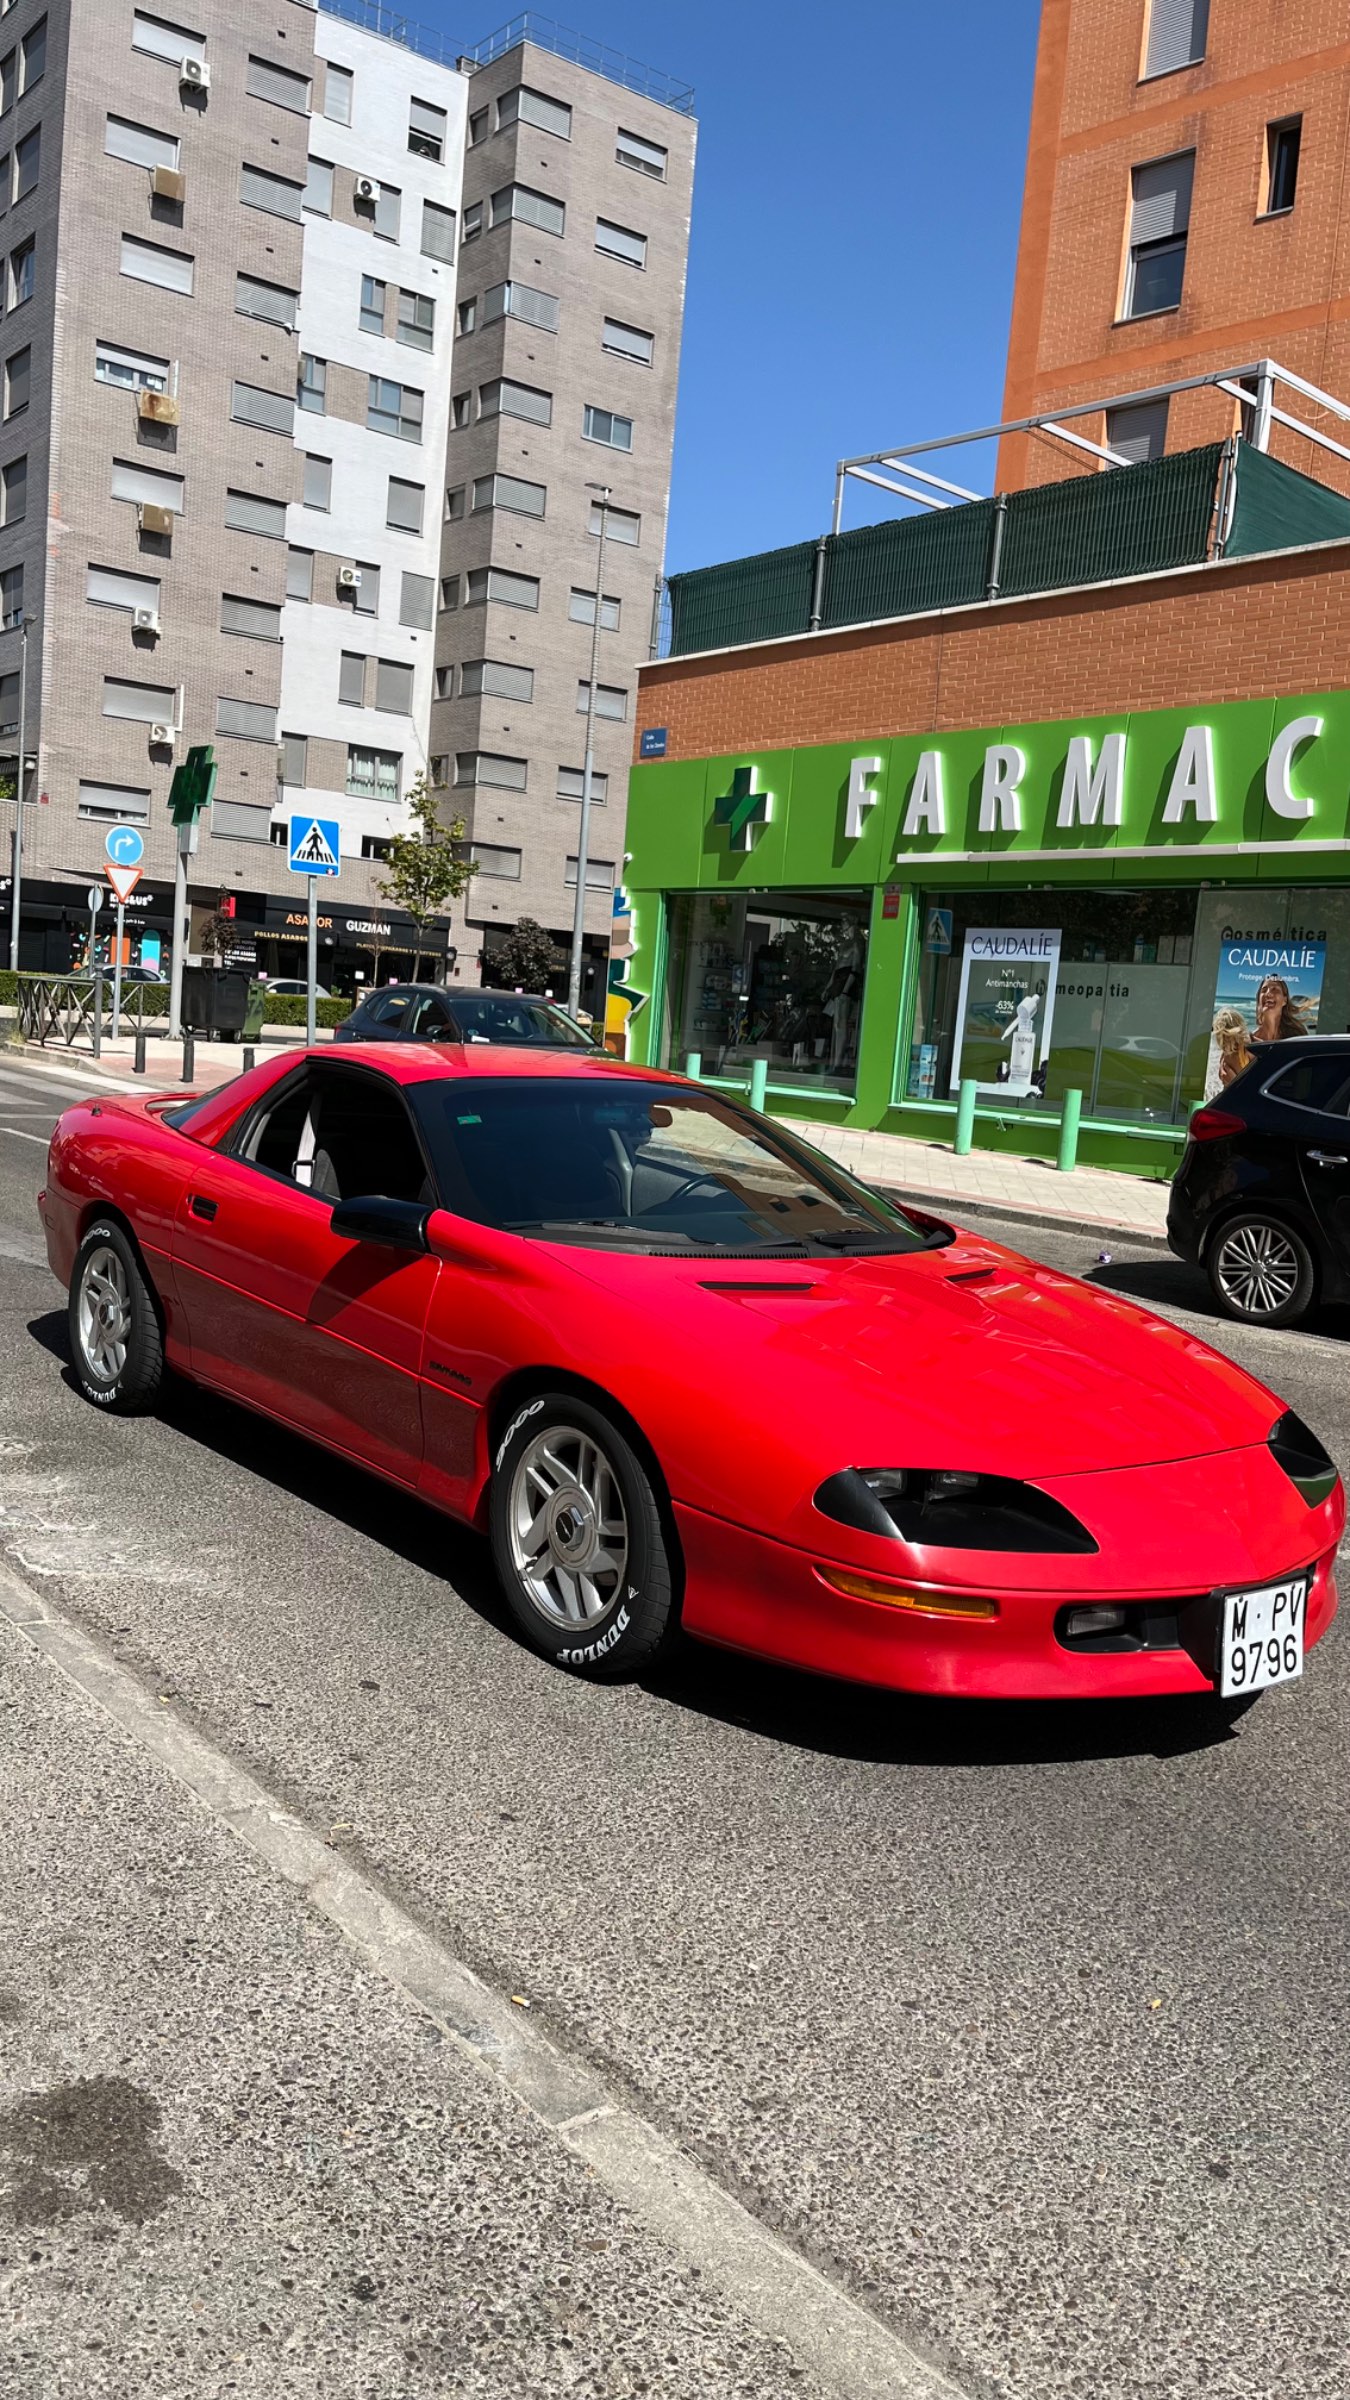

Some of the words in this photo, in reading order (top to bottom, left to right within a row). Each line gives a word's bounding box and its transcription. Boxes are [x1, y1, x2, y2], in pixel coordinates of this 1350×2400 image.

[844, 715, 1324, 838] FARMAC
[254, 930, 280, 939] POLLOS
[281, 933, 309, 942] ASADOS
[286, 913, 333, 929] ASAOR
[346, 919, 391, 936] GUZMAN
[1228, 945, 1317, 968] CAUDALÍE
[985, 978, 1029, 989] Antimanchas
[556, 1605, 631, 1665] DUNLOP
[1231, 1633, 1298, 1687] 9796
